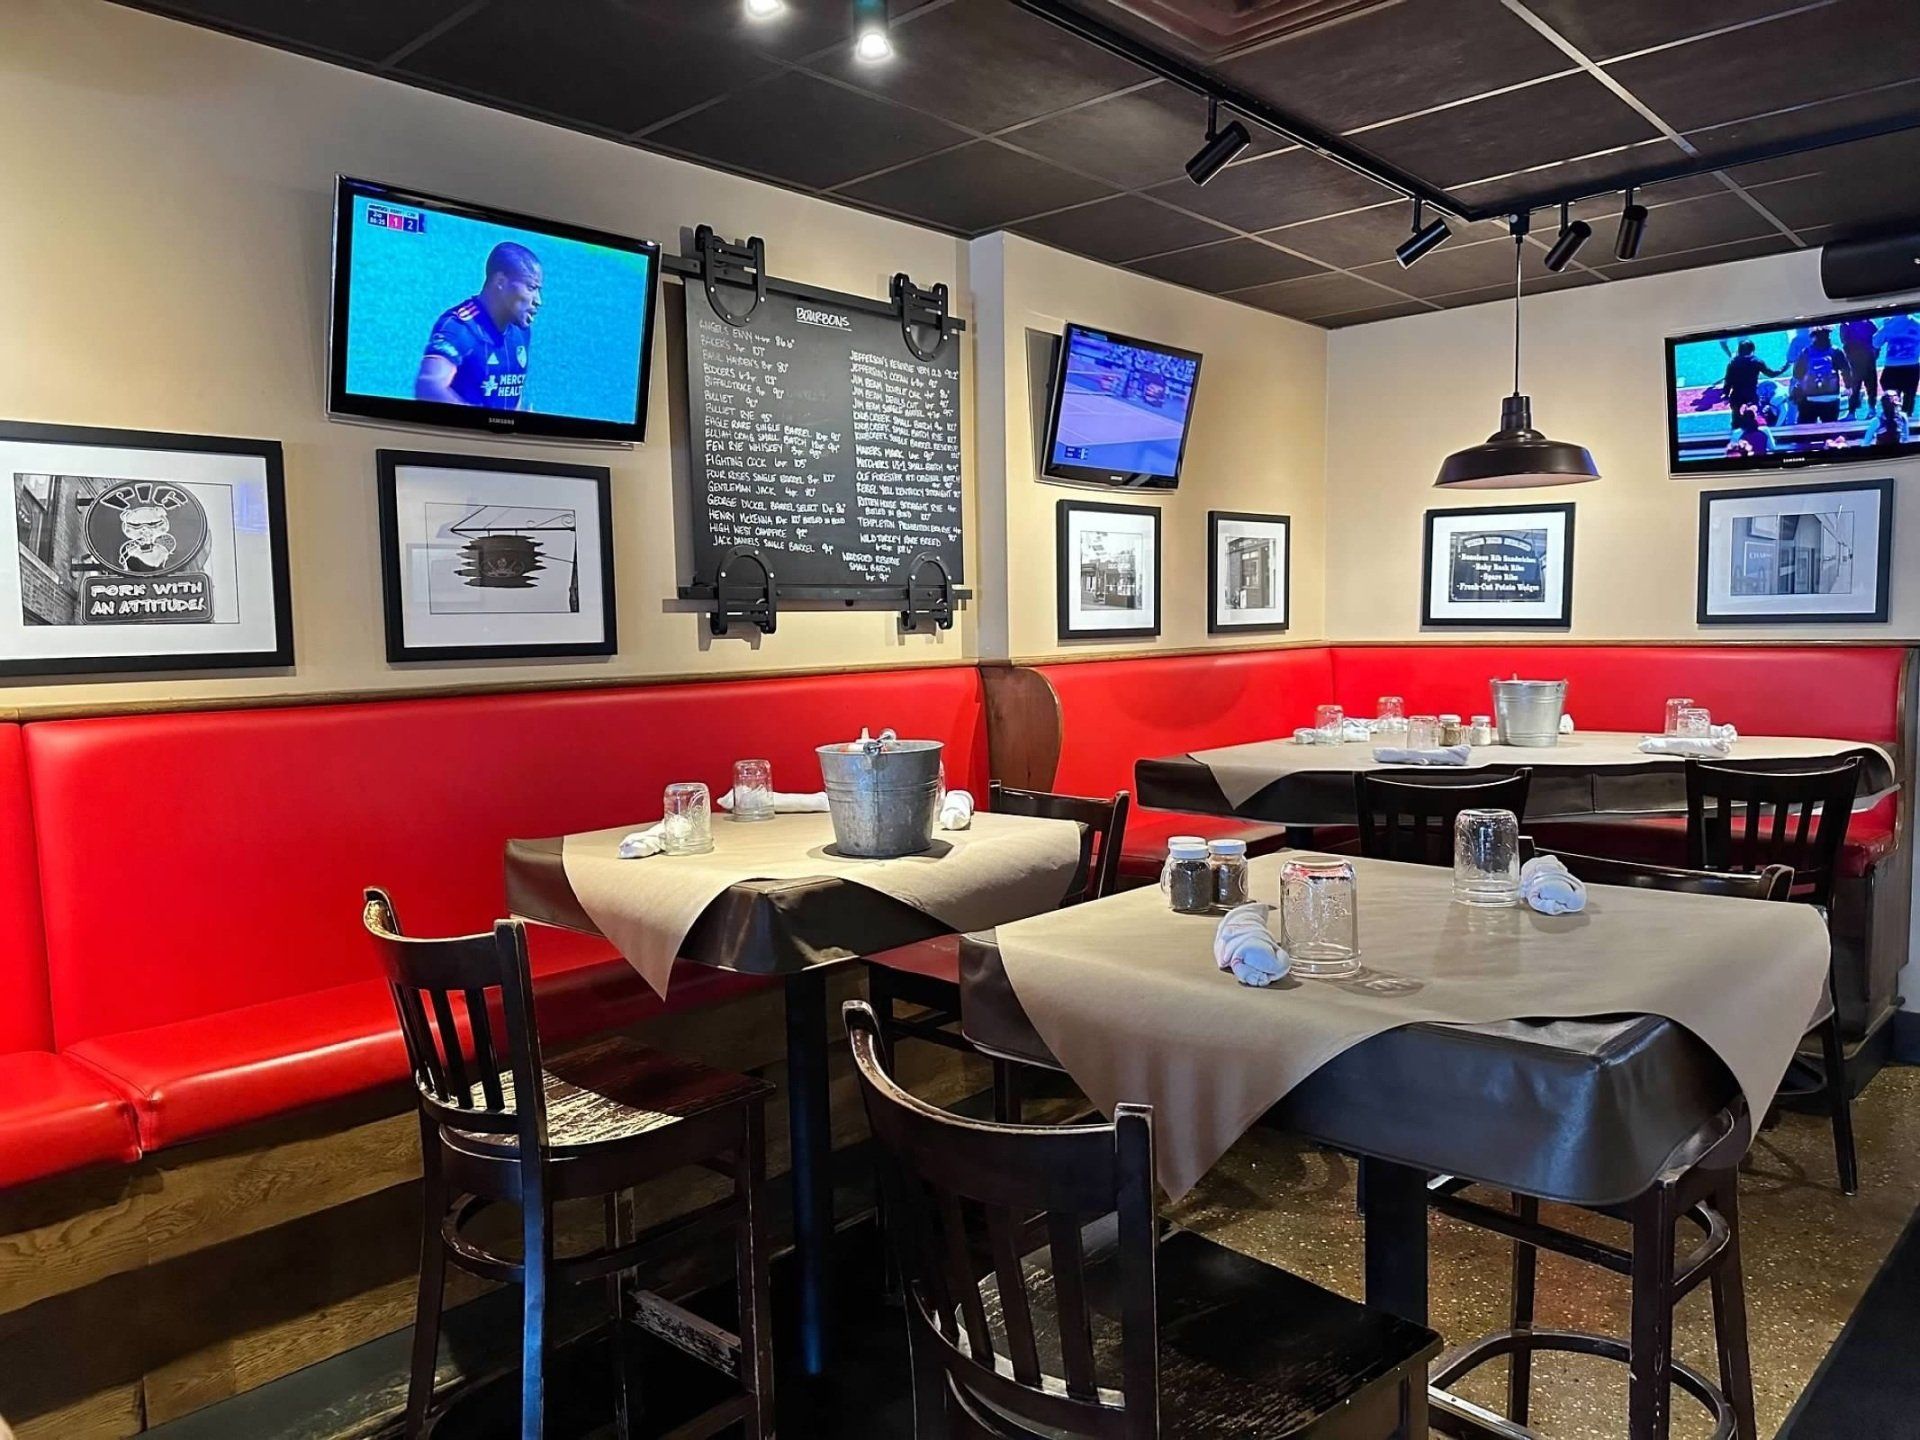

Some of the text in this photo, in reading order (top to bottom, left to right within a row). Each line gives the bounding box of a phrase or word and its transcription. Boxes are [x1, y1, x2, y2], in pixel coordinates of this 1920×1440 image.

[393, 217, 398, 228] 1
[407, 220, 414, 230] 2
[796, 307, 850, 327] BOURBONS
[864, 377, 884, 391] BEAM
[864, 389, 883, 402] BEAM
[865, 401, 882, 413] BEAM
[740, 410, 755, 421] RYE
[704, 415, 729, 428] EAGLE
[731, 419, 752, 430] RARE
[755, 423, 780, 433] SINGLE
[783, 425, 813, 438] BARREL
[757, 433, 780, 442] SMALL
[728, 441, 744, 452] RYE
[705, 453, 743, 468] FIGHTING
[747, 456, 767, 468] COCK
[706, 469, 727, 480] FOUR
[727, 470, 750, 481] ROSES
[752, 472, 777, 482] SINGLE
[707, 480, 752, 494] GENTLEMAN
[755, 485, 777, 497] JACK
[100, 482, 188, 511] PIG
[706, 493, 737, 508] GEORGE
[796, 503, 819, 513] SELECT
[708, 508, 736, 523] HENRY
[709, 522, 730, 534] HIGH
[733, 524, 752, 536] WEST
[857, 516, 895, 529] TEMPLETON
[713, 535, 733, 546] JACK
[849, 562, 869, 572] SMALL
[91, 582, 203, 597] PORK WITH
[90, 598, 207, 615] AN ATTITUDE!
